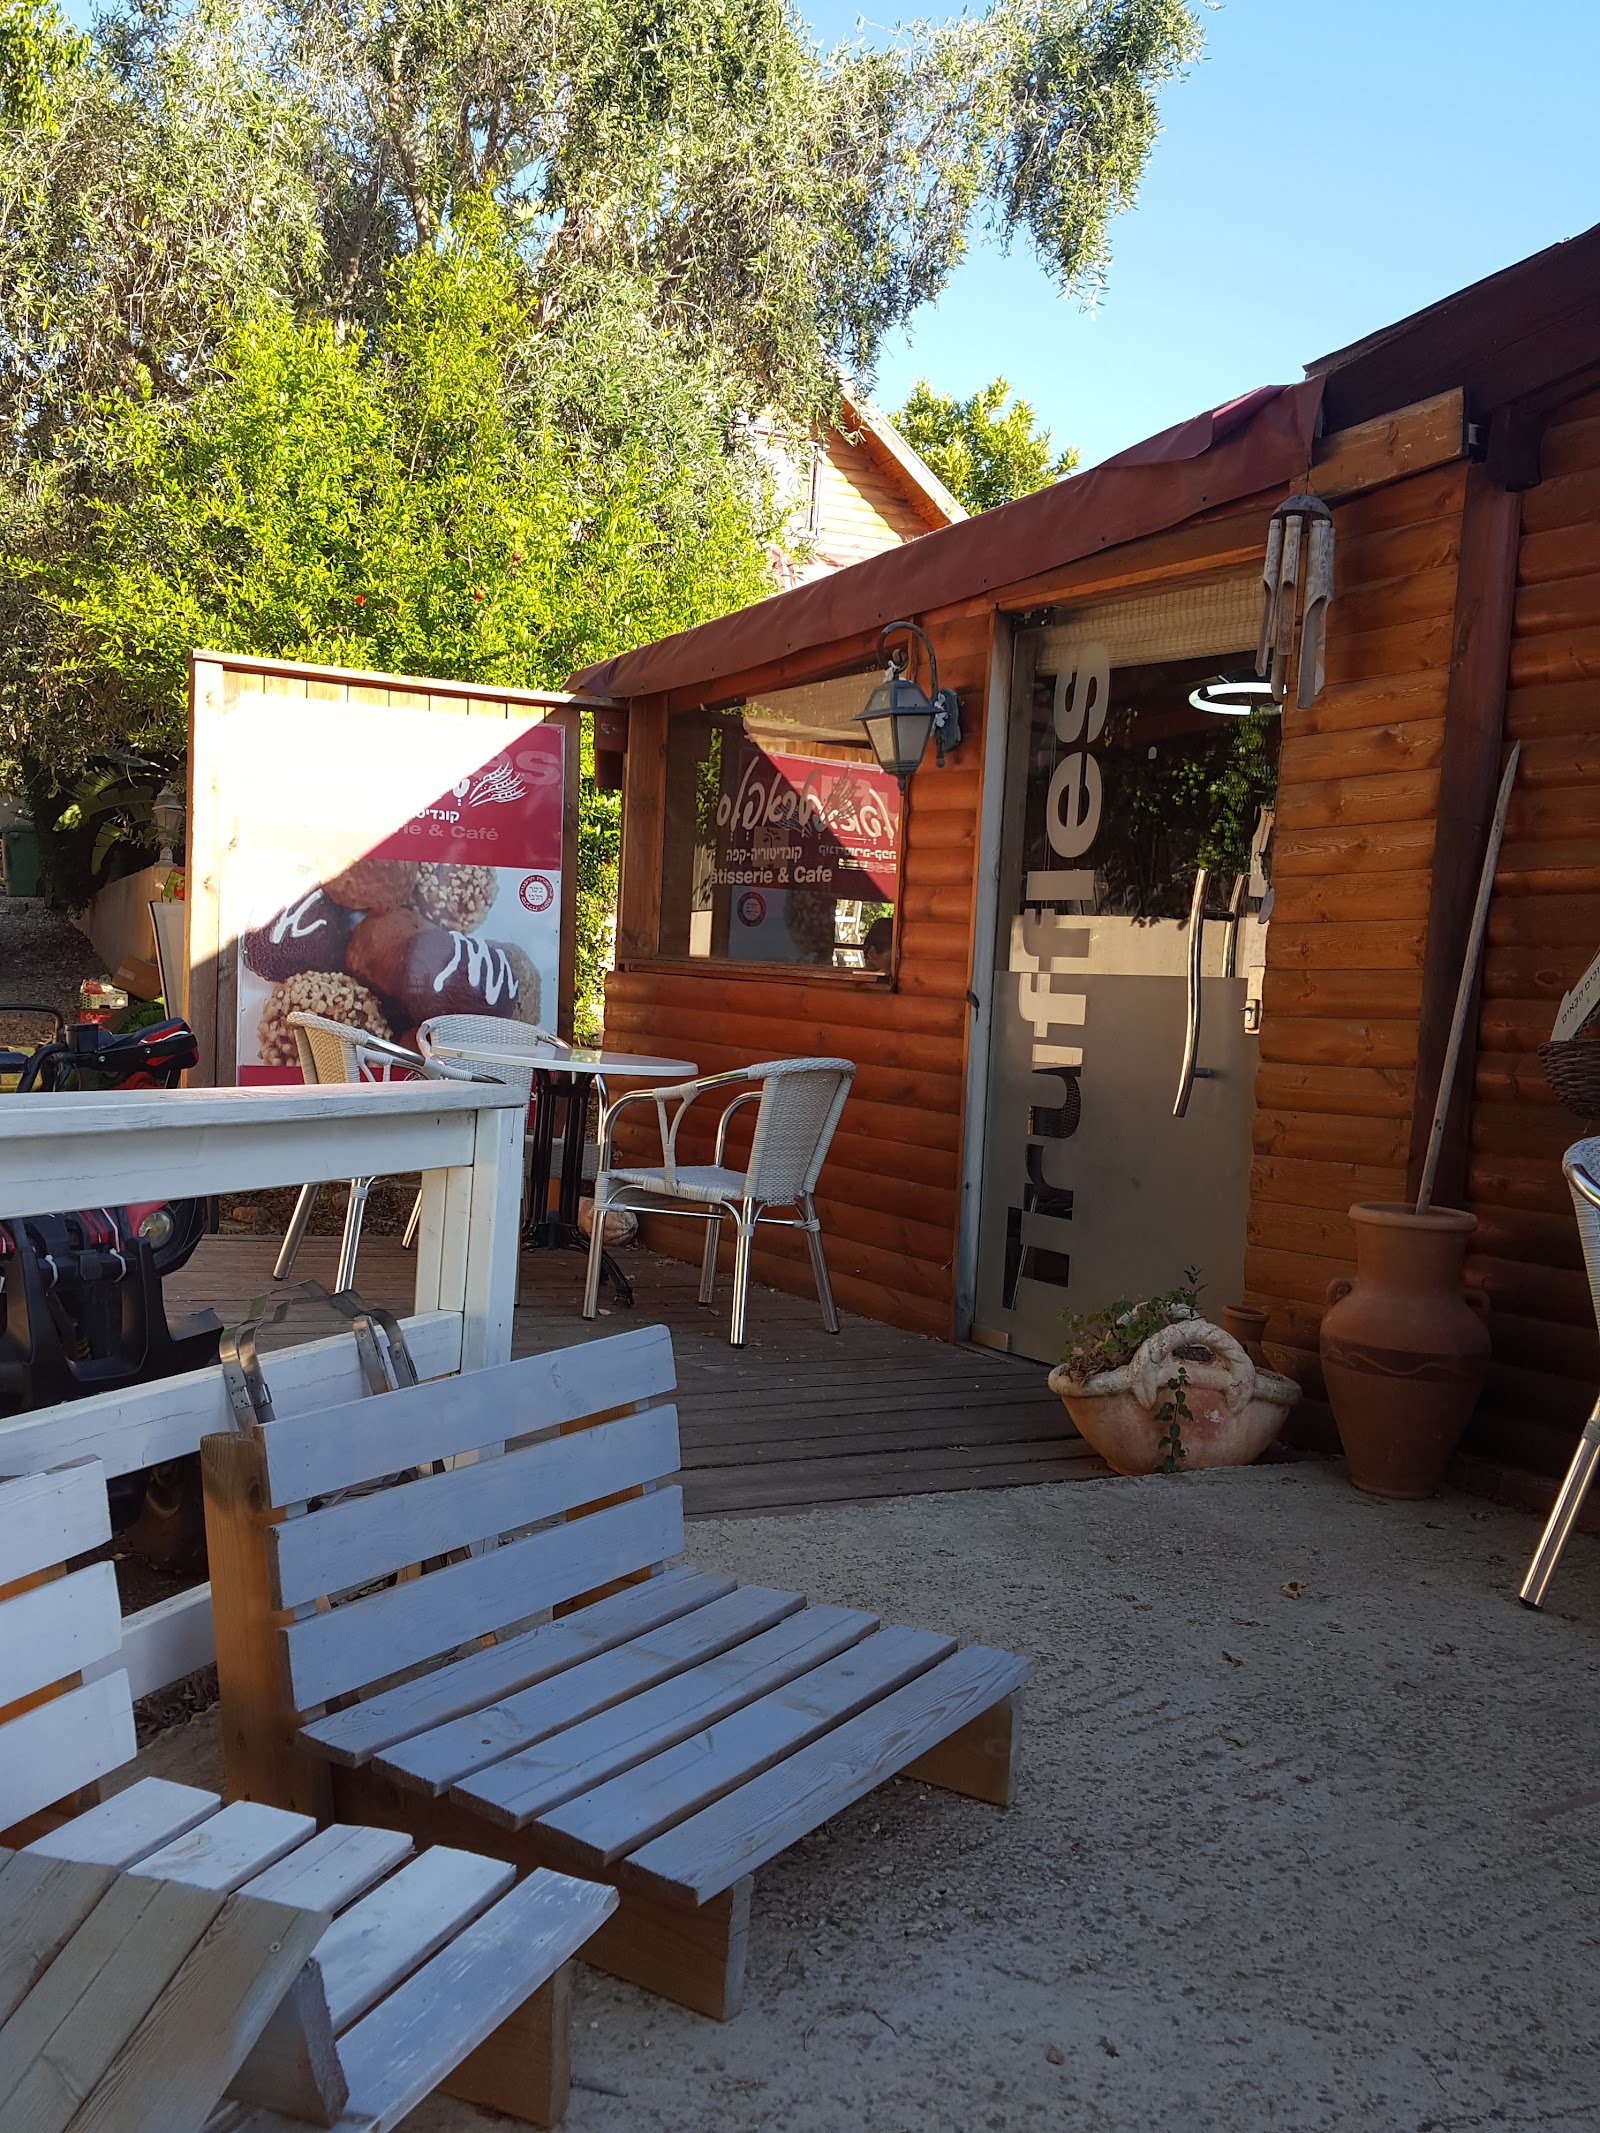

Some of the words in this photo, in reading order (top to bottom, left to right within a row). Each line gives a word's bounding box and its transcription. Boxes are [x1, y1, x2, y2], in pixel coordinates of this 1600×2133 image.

[429, 824, 444, 837] &
[450, 825, 499, 841] Café
[777, 866, 790, 884] &
[1002, 641, 1111, 1311] Truffles
